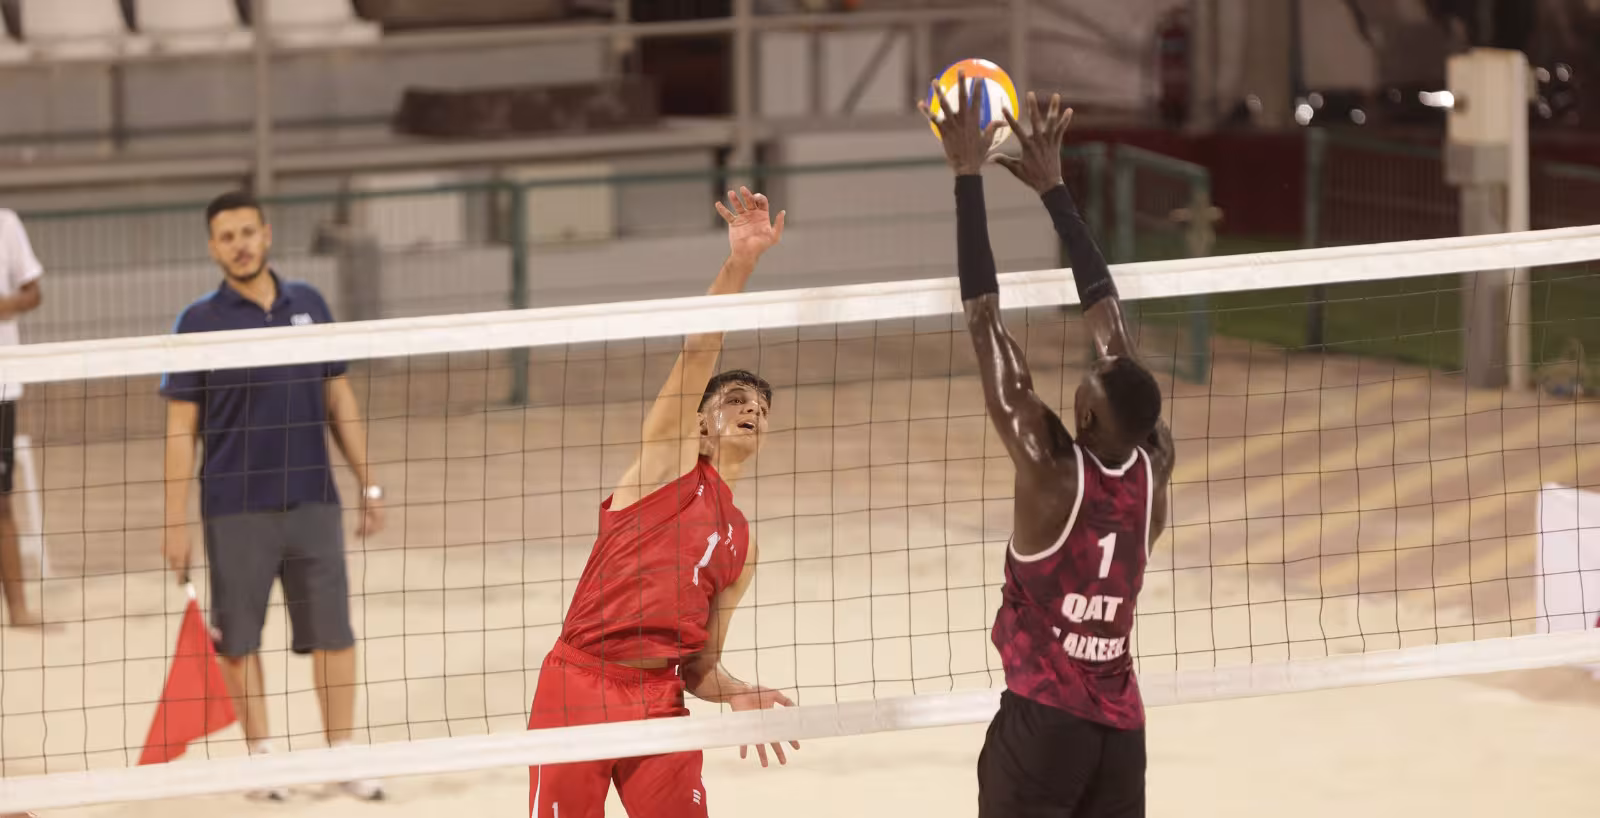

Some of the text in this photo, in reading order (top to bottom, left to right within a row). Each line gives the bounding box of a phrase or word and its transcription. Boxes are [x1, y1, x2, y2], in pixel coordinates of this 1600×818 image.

[691, 531, 721, 587] 1
[1097, 532, 1117, 579] 1
[1061, 592, 1124, 623] QAT
